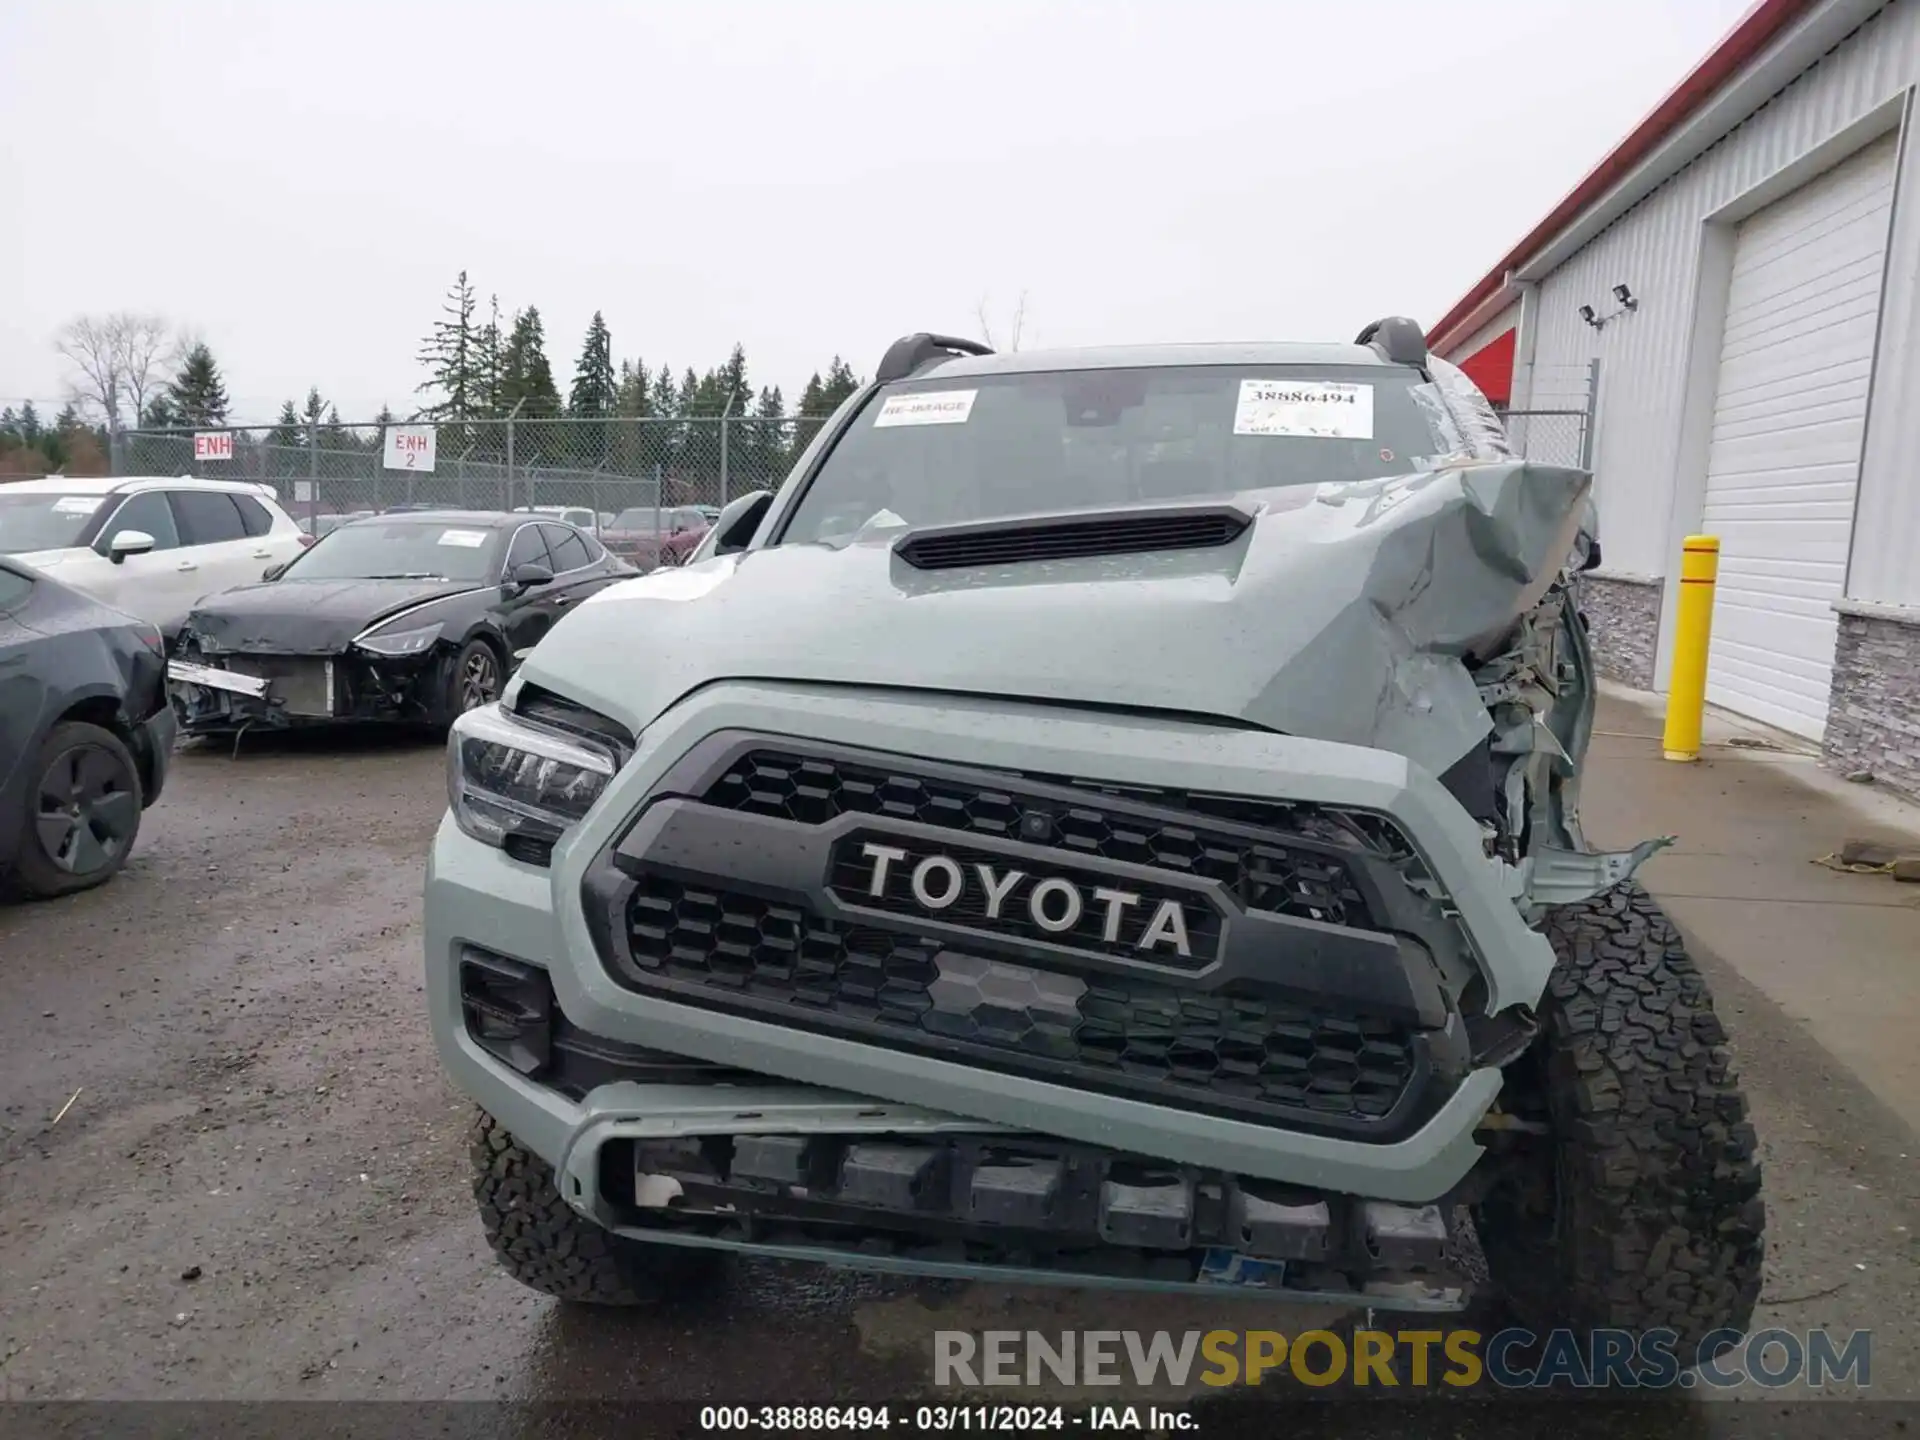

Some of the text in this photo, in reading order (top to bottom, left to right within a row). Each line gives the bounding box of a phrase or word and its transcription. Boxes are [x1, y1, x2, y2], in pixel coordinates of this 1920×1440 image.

[195, 436, 232, 456] ENH
[395, 434, 428, 451] ENH
[405, 452, 416, 468] 2
[862, 841, 1192, 957] TOYOTA
